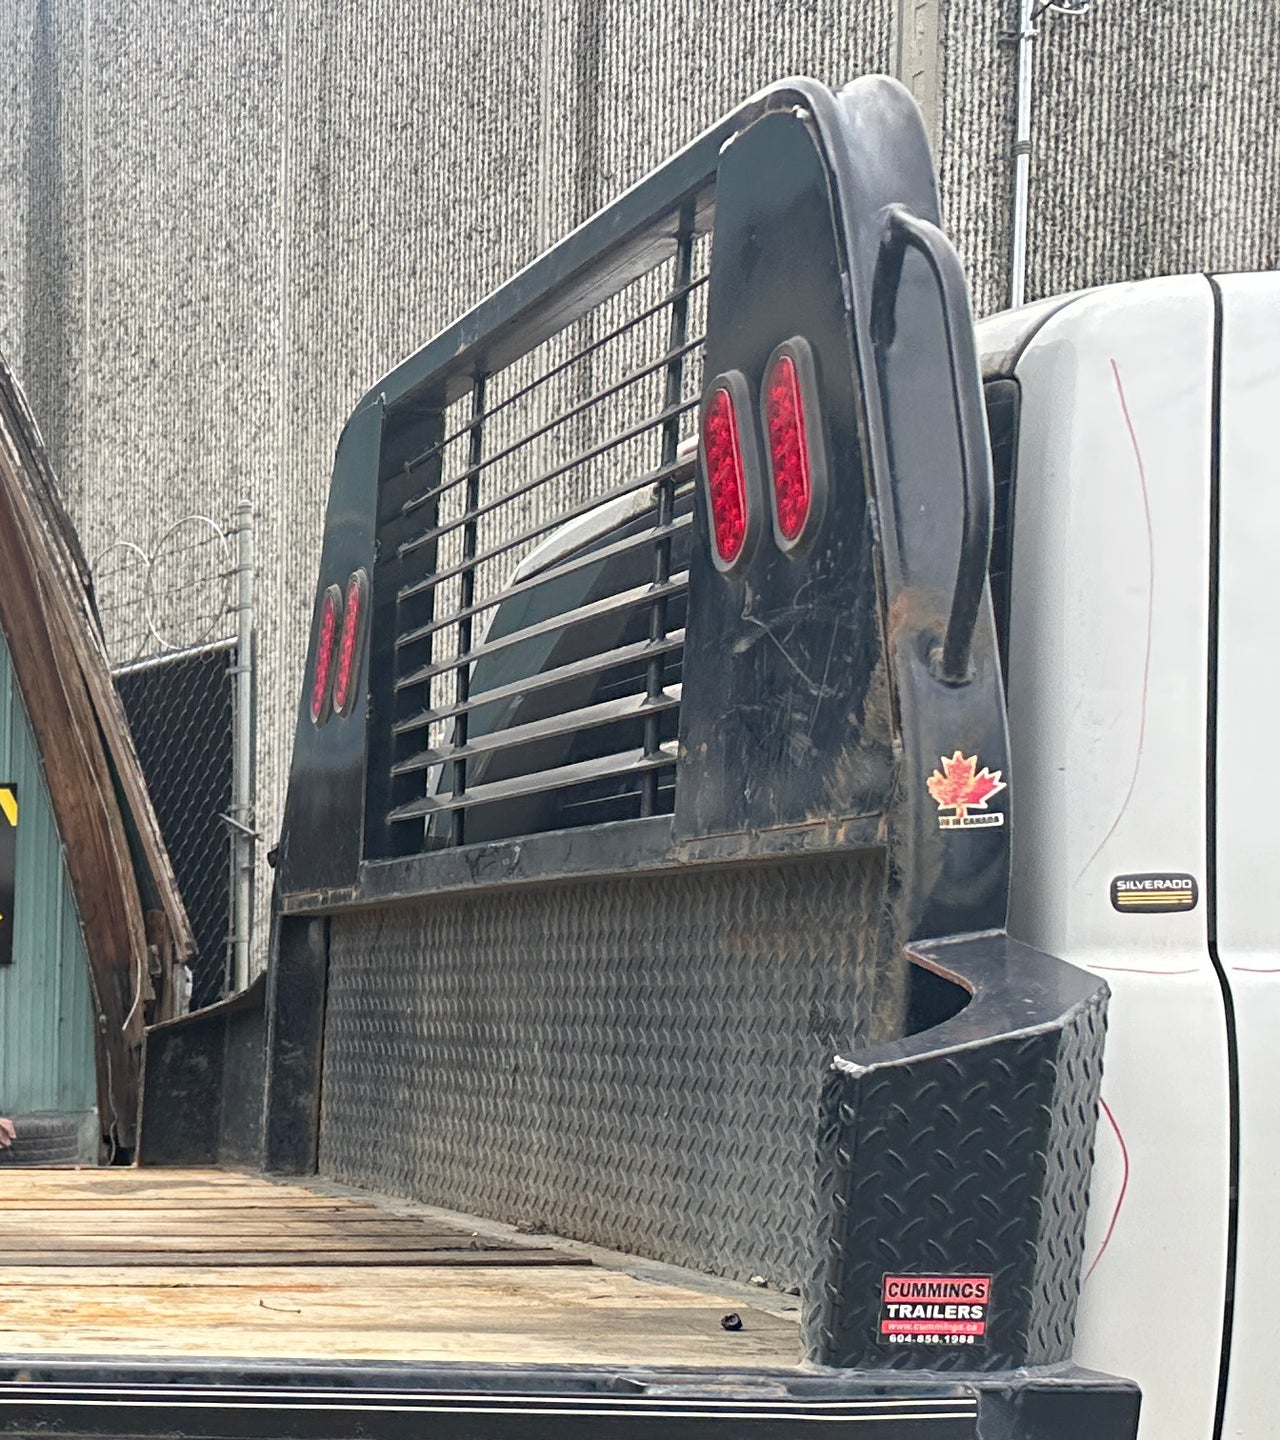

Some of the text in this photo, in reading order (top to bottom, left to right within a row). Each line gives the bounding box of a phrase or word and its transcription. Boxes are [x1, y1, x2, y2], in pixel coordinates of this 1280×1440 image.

[1116, 879, 1192, 890] SILVERADO
[888, 1282, 986, 1299] CUMMINGS
[887, 1304, 983, 1319] TRAILERS
